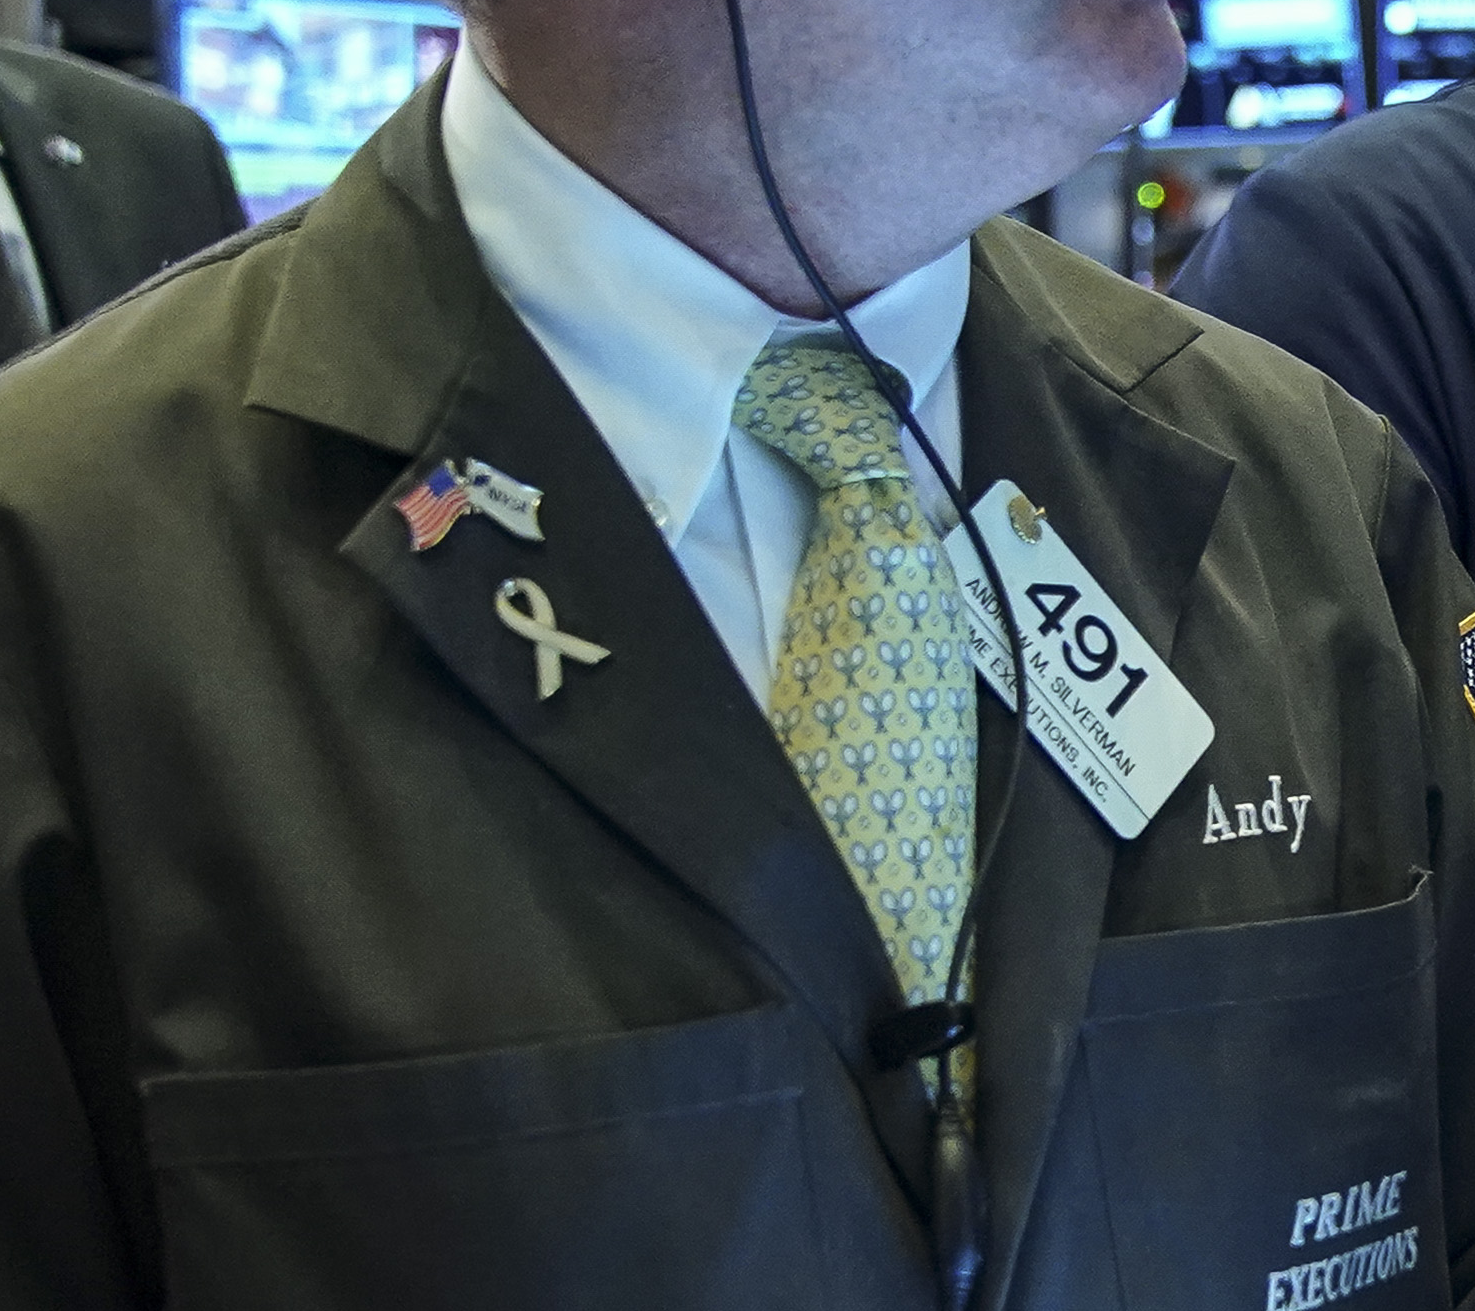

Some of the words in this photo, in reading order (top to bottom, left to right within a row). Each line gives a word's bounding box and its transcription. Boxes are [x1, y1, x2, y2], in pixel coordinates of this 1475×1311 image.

[1025, 582, 1150, 719] 491
[1050, 675, 1137, 778] SILVERMAN
[1202, 774, 1312, 854] Andy
[1288, 1169, 1408, 1248] PRIME
